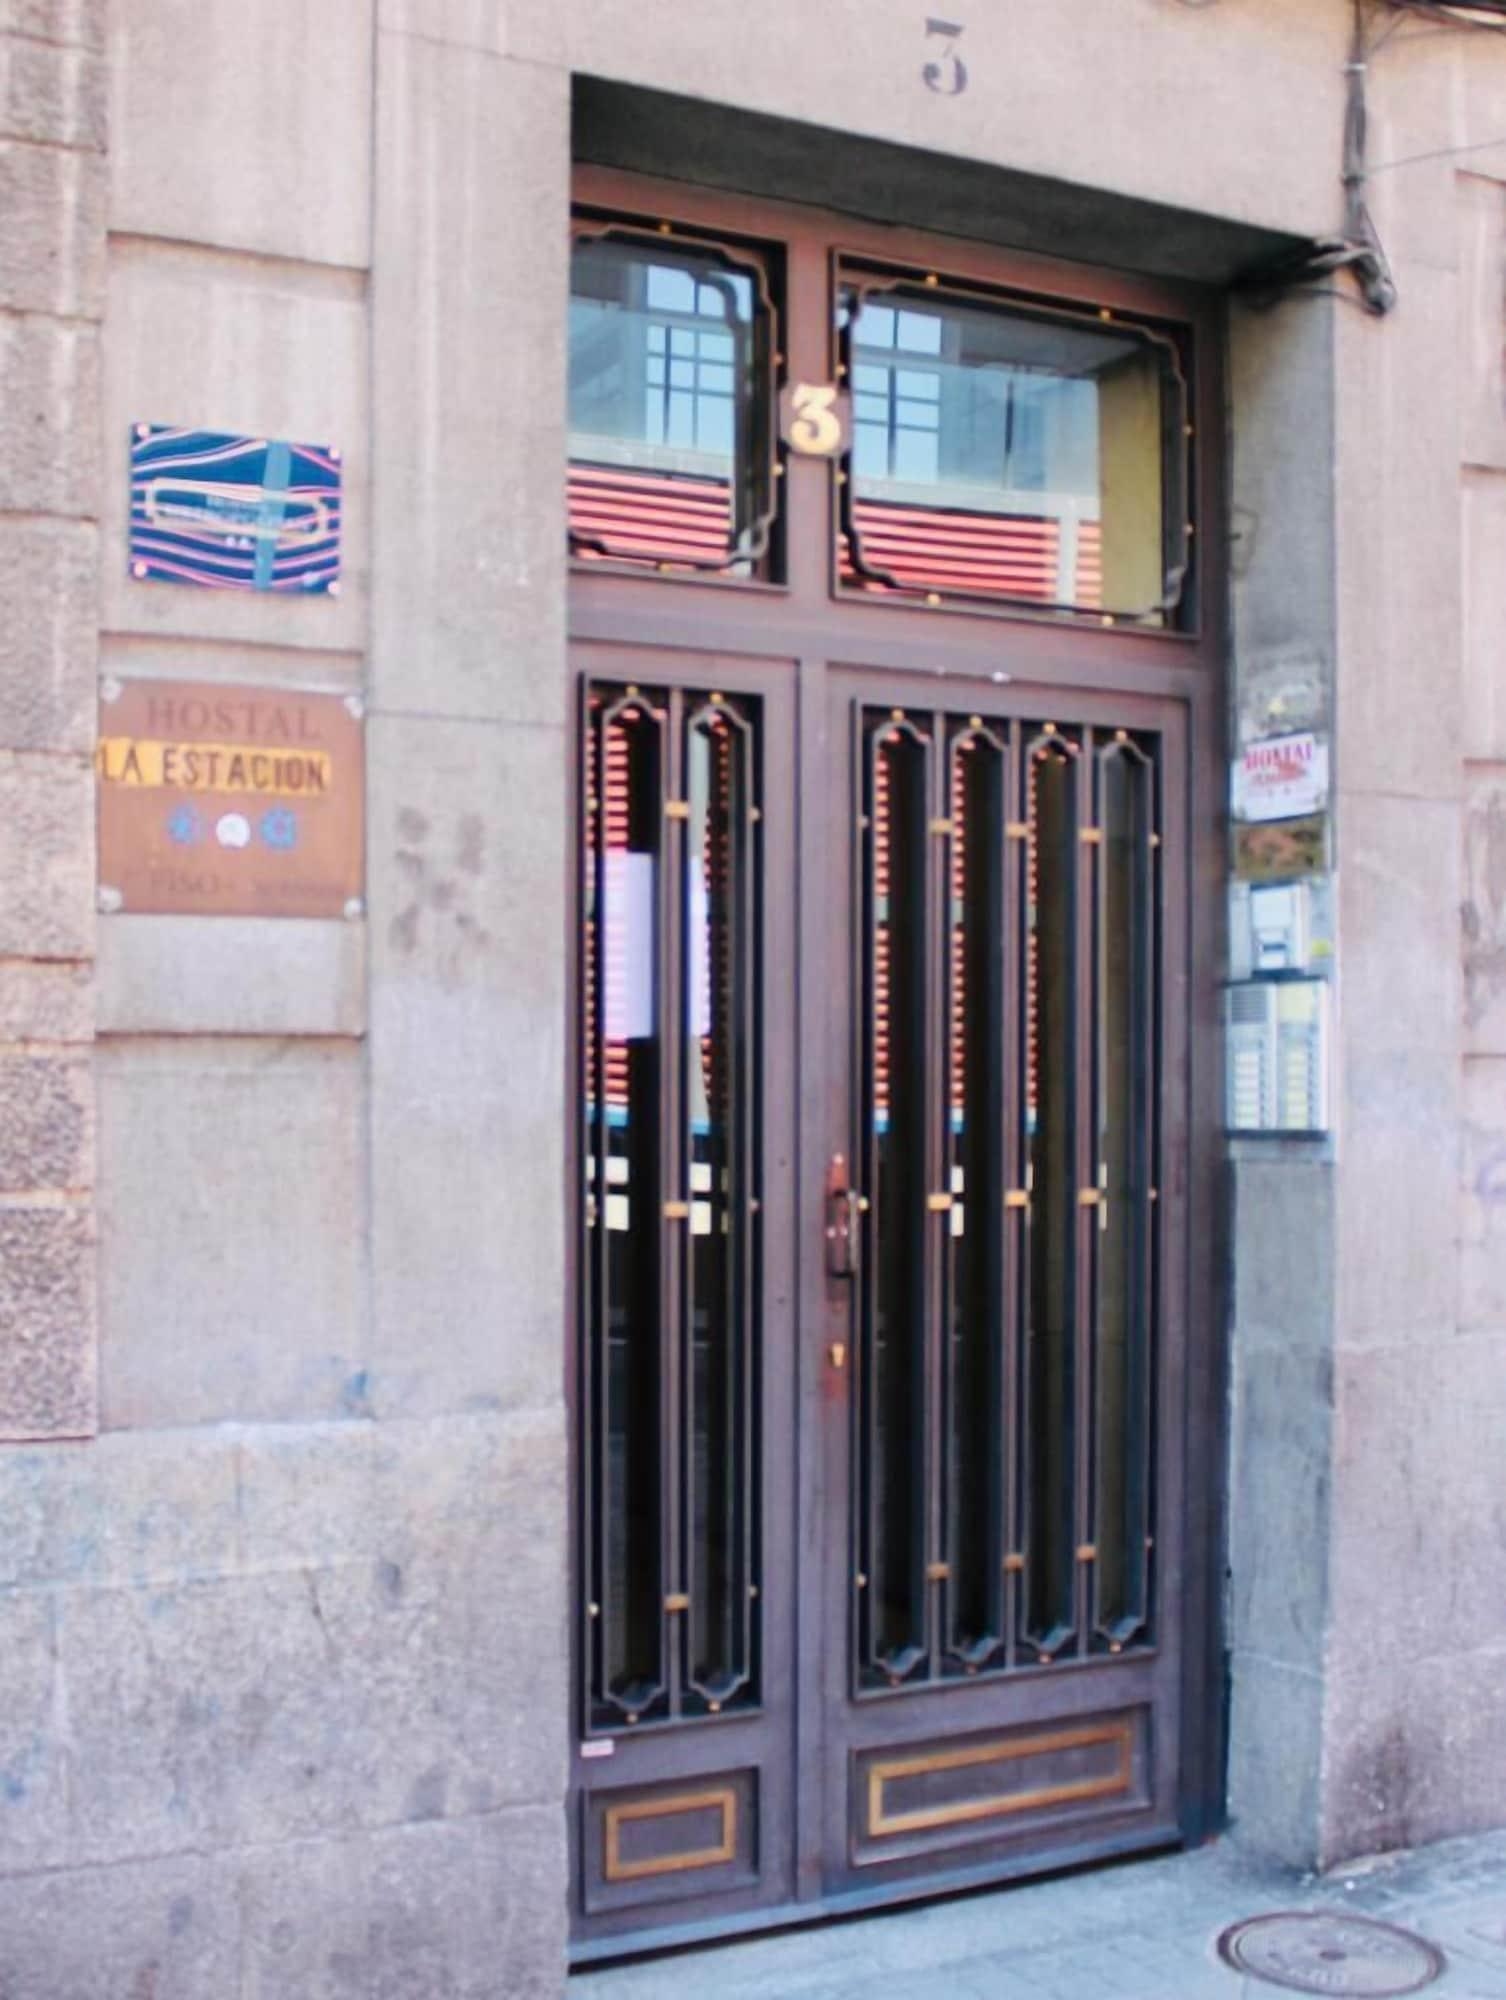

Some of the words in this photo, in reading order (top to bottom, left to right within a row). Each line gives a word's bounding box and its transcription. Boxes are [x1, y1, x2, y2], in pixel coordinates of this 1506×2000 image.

[922, 17, 968, 96] 3
[791, 383, 840, 455] 3
[146, 697, 322, 740] HOSTAL
[101, 746, 142, 783] LA
[162, 747, 325, 791] ESTACION
